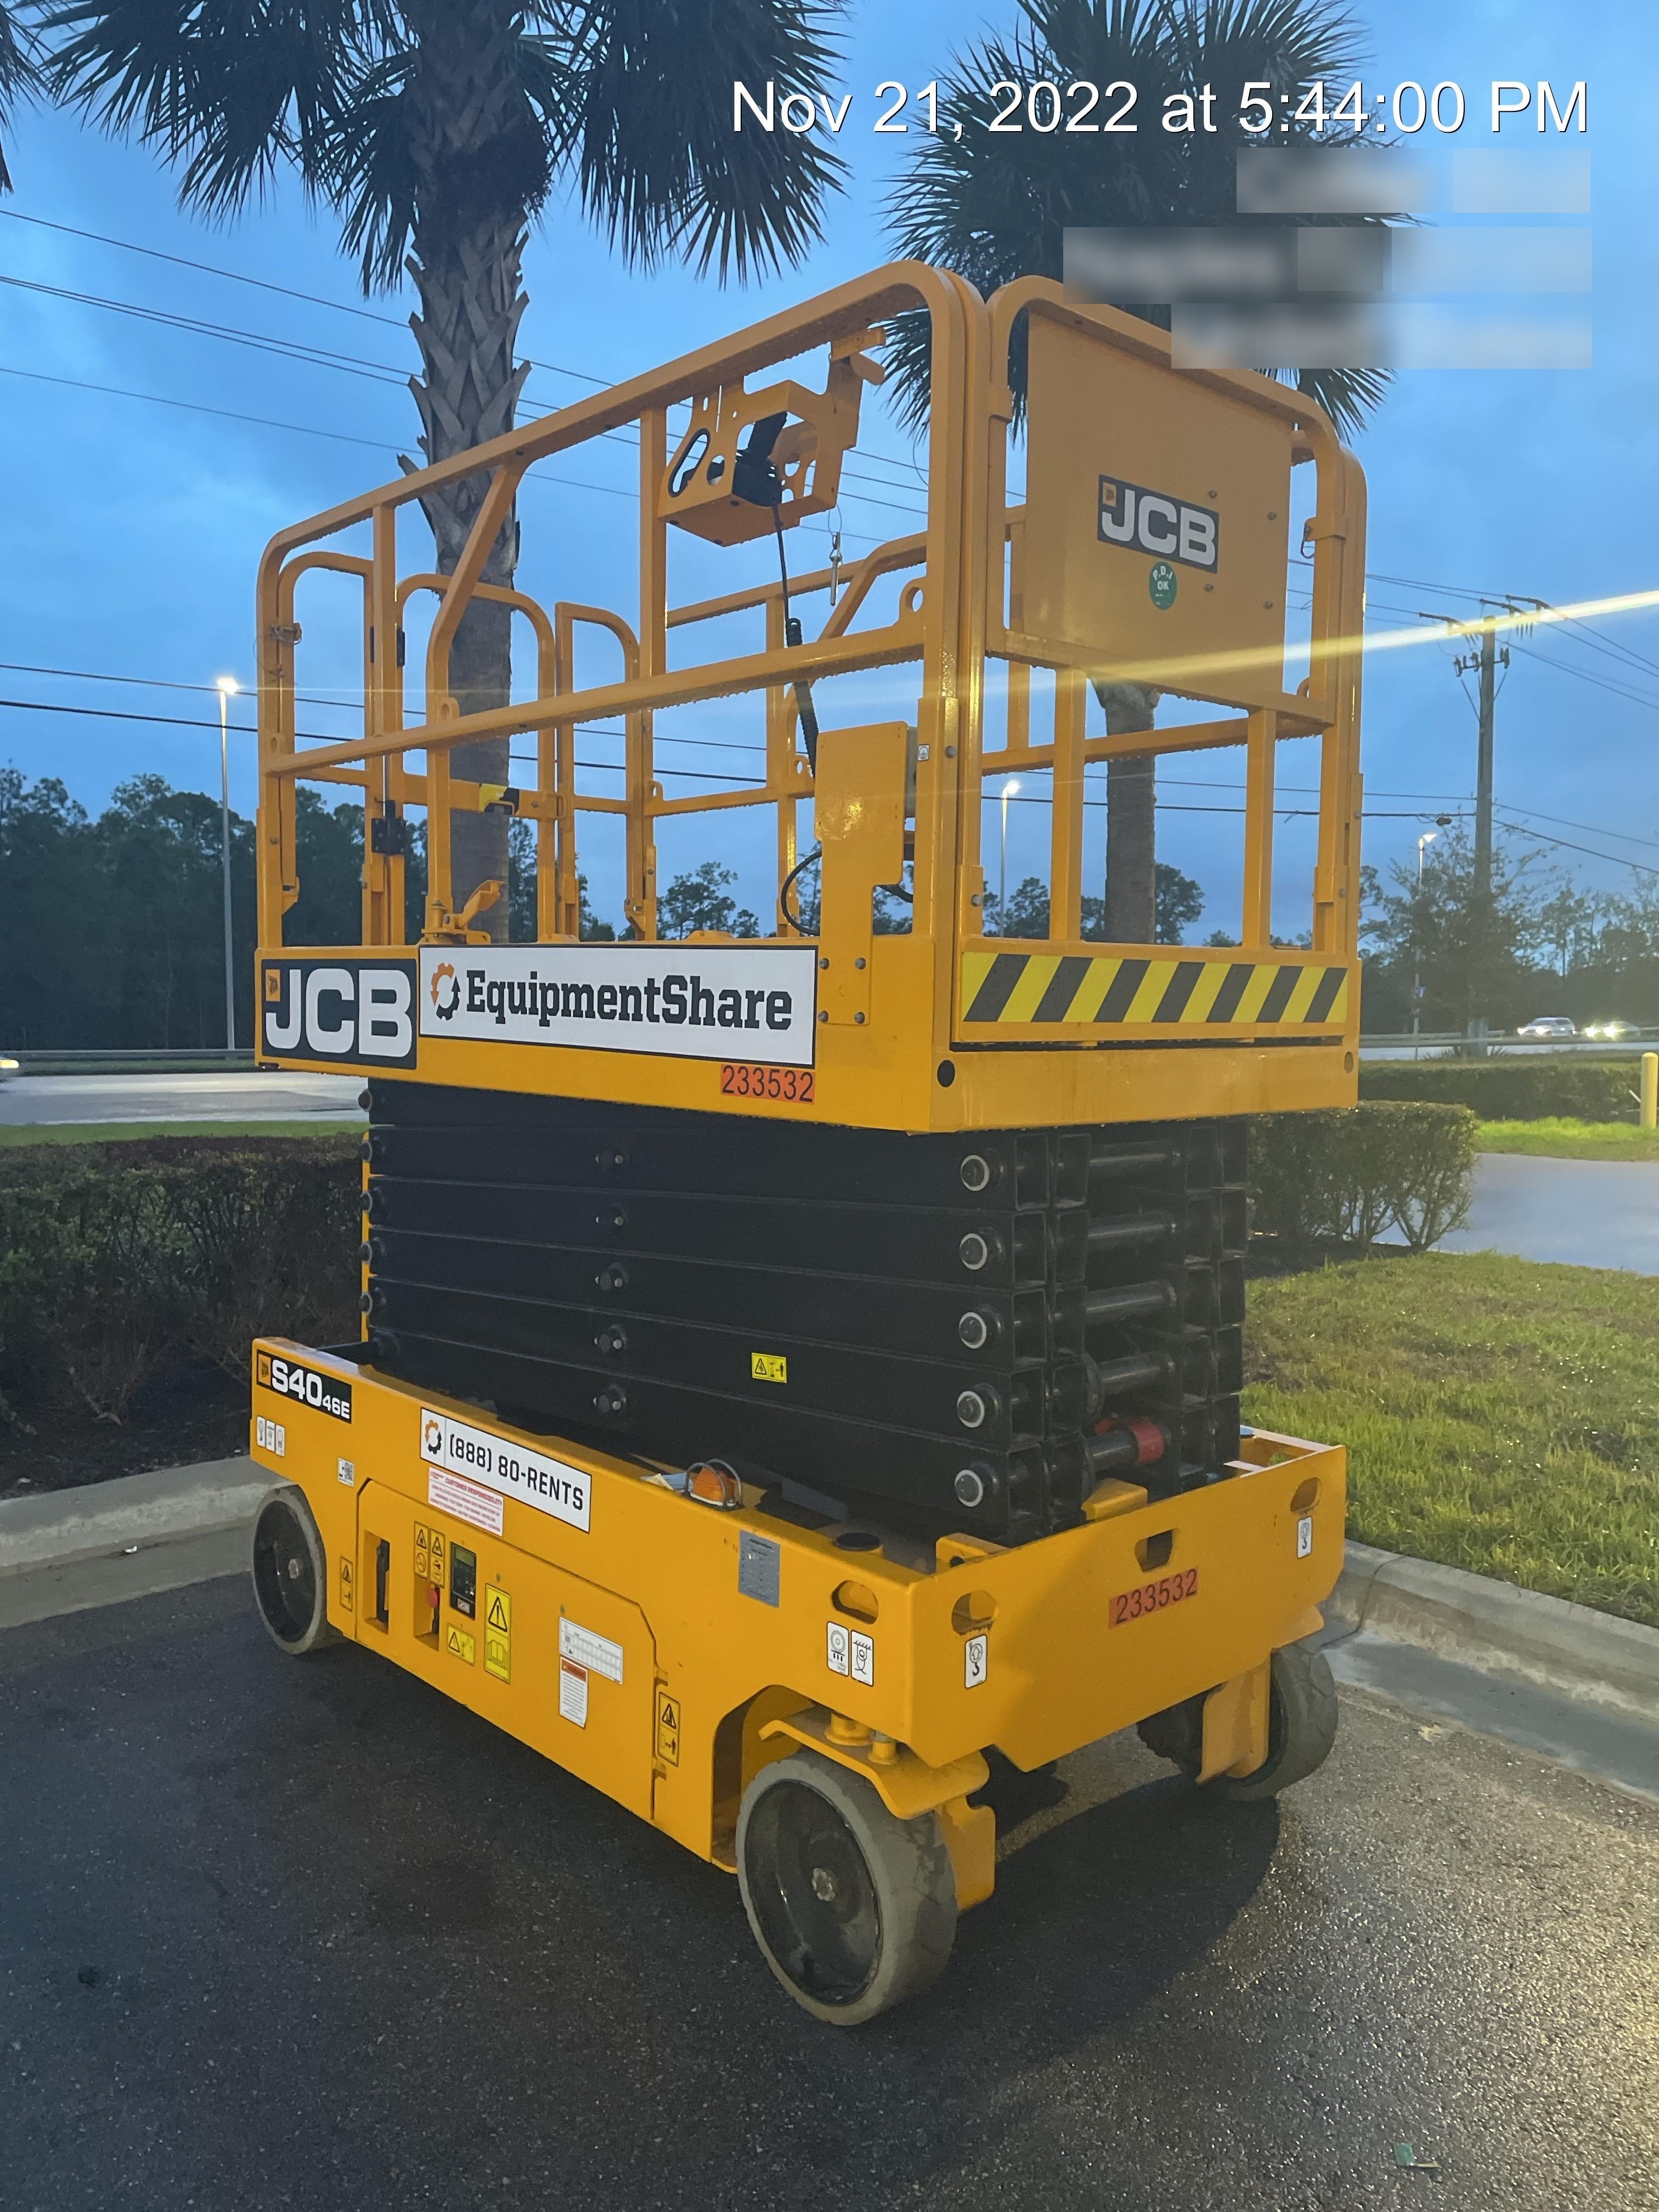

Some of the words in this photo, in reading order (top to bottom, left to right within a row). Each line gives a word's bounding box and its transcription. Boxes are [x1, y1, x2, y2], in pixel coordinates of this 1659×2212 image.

[1102, 488, 1216, 566] JCB
[1157, 580, 1169, 590] OK
[266, 968, 412, 1058] JCB
[466, 969, 792, 1030] EquipmentShare
[722, 1065, 814, 1103] 233532
[450, 1434, 492, 1472] (888)
[498, 1455, 583, 1511] 80-RENTS
[1116, 1568, 1197, 1624] 233532
